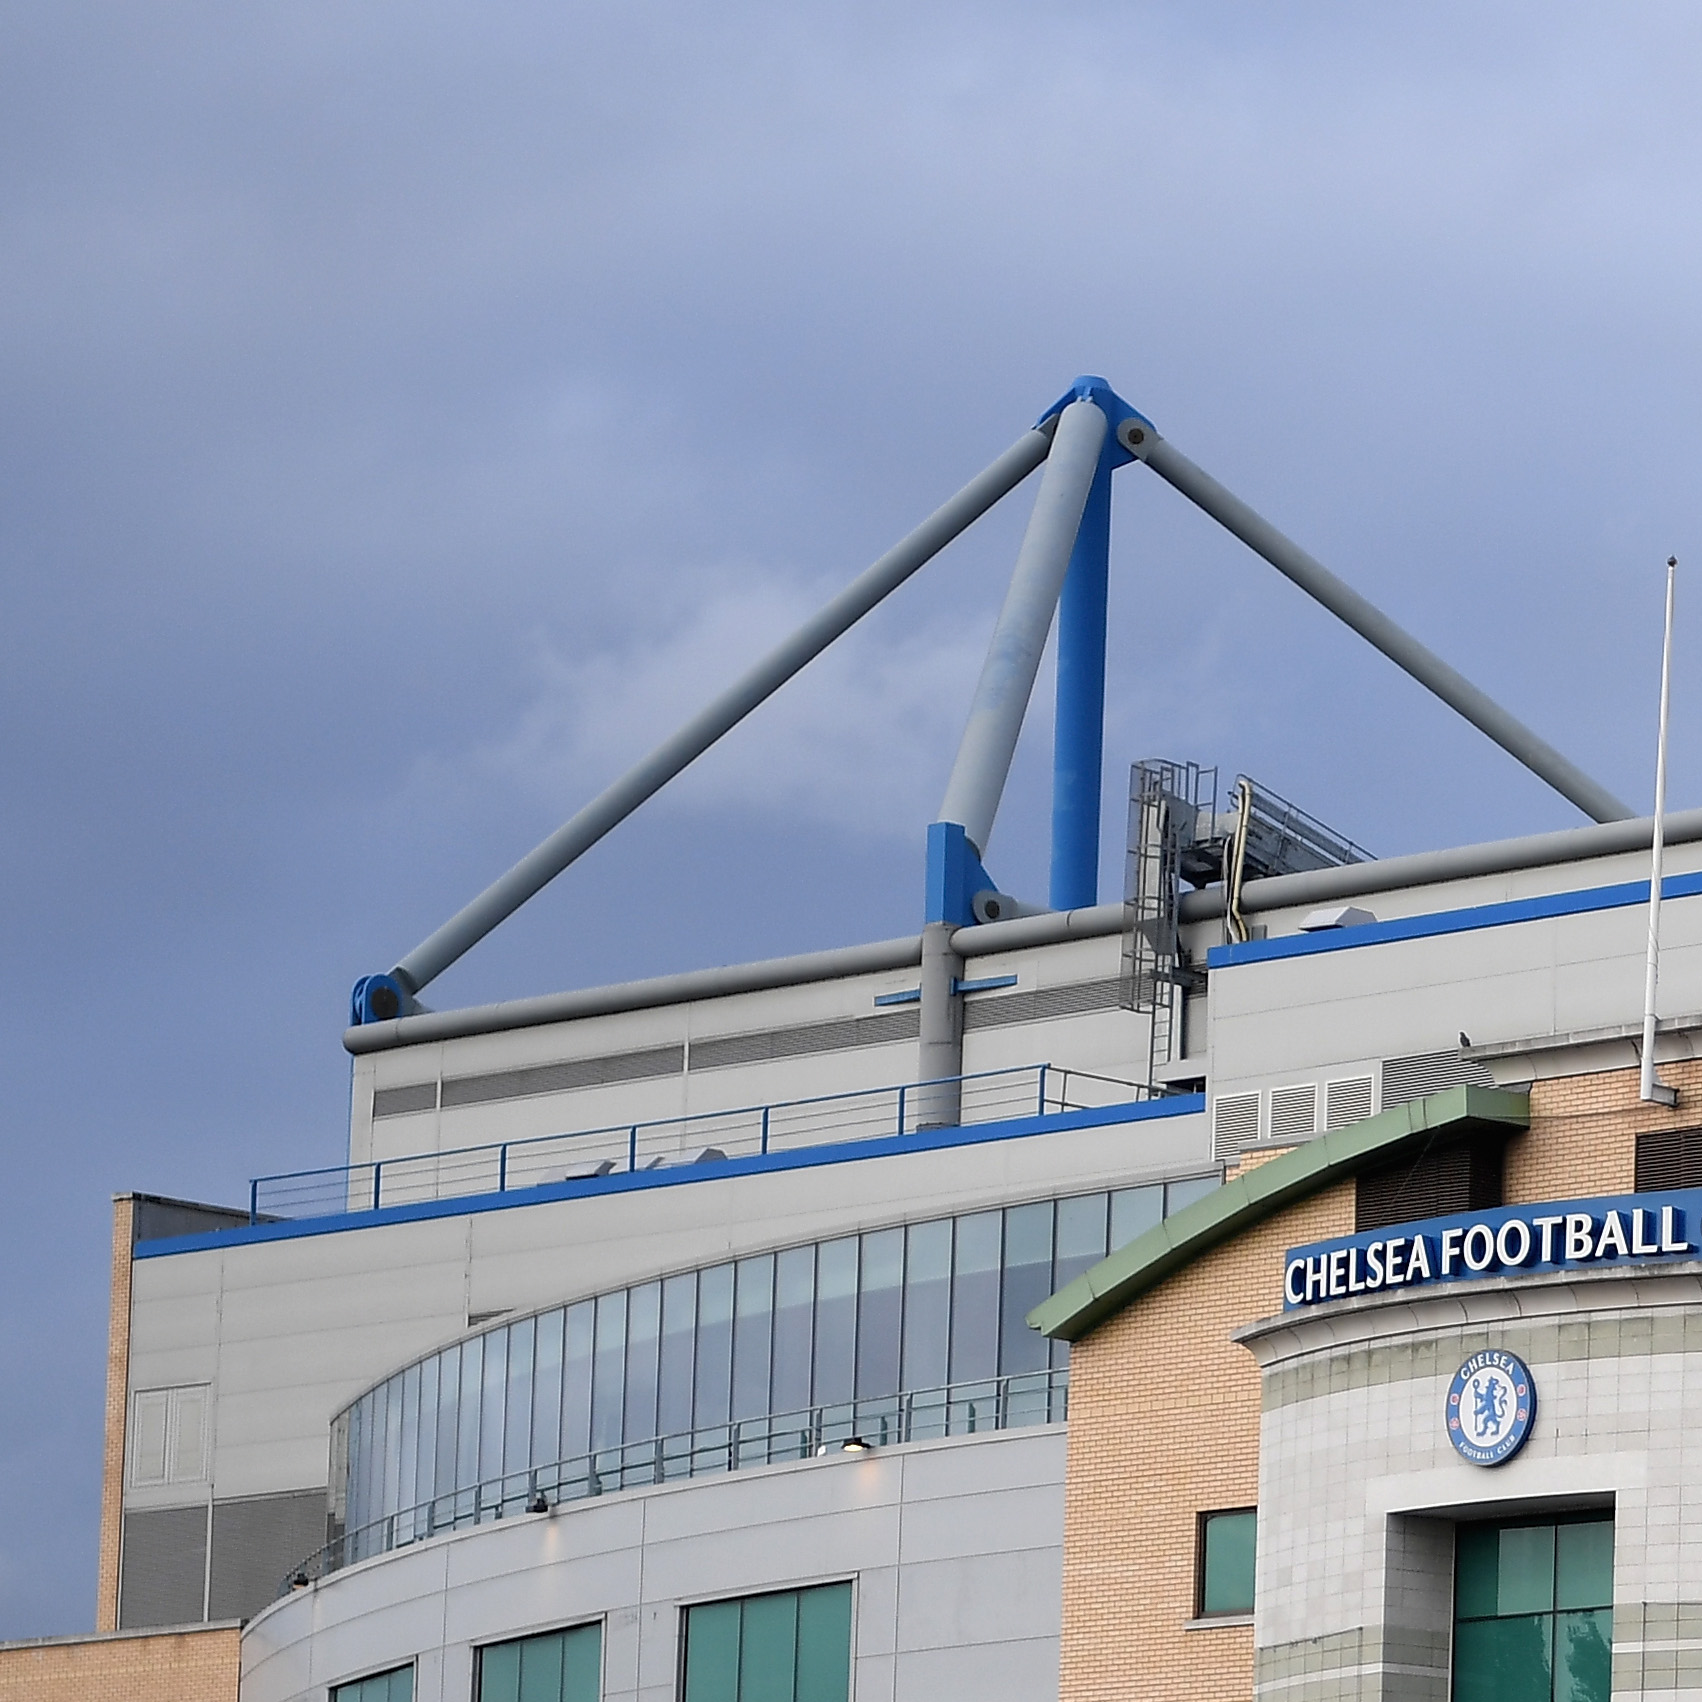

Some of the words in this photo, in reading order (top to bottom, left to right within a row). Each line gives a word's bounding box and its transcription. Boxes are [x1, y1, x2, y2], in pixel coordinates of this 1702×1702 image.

[1285, 1233, 1433, 1306] CHELSEA
[1440, 1205, 1689, 1273] FOOTBALL
[1460, 1352, 1514, 1380] CHELSEA
